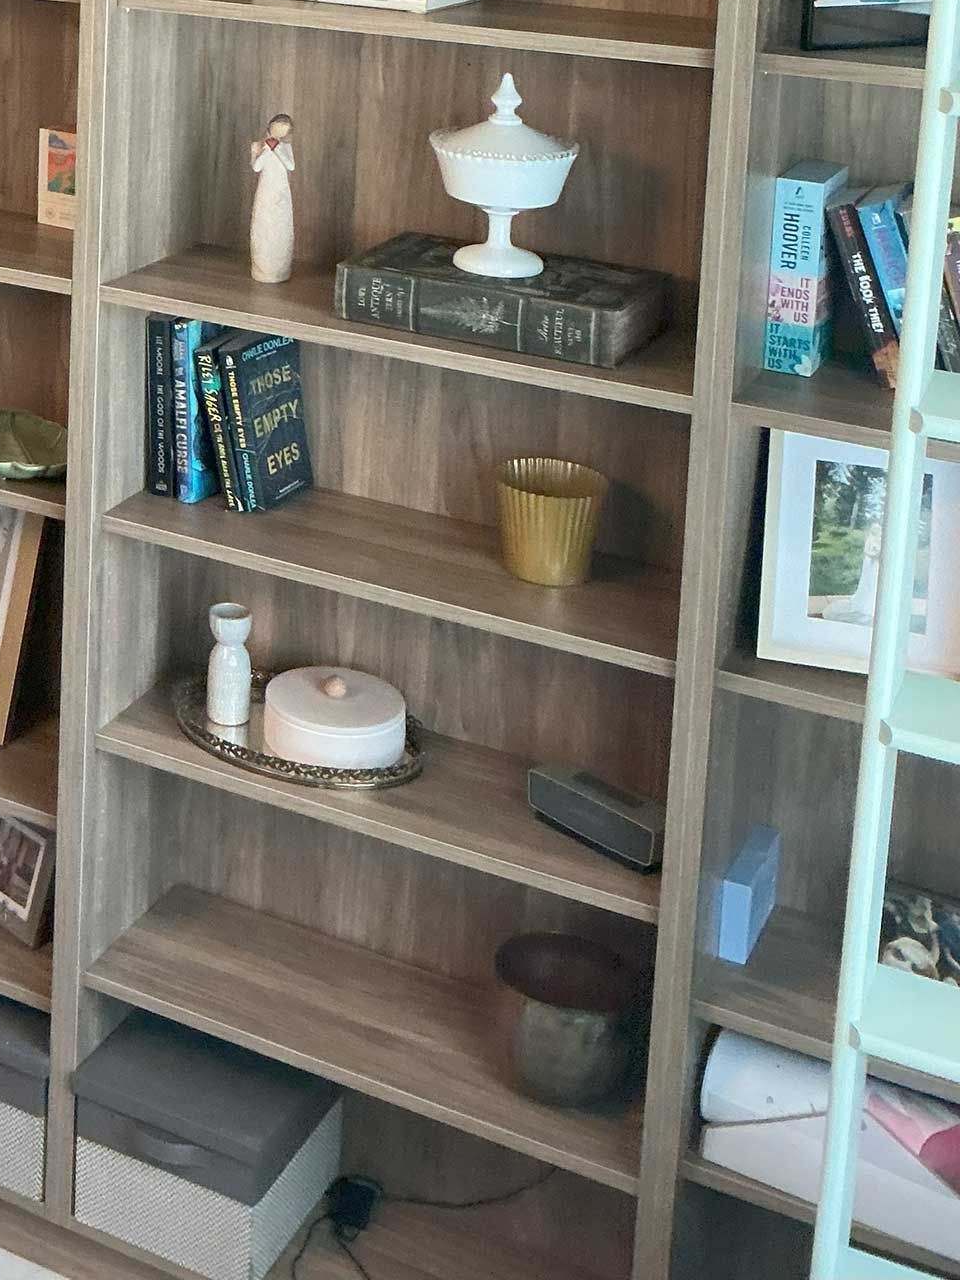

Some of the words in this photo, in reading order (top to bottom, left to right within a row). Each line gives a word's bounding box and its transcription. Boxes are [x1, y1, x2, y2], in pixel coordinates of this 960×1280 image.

[780, 212, 801, 270] HOOVER
[800, 225, 812, 261] COLLEEN
[780, 286, 810, 301] ENDS
[800, 277, 810, 289] IT
[371, 277, 383, 320] ANTIQUE
[780, 299, 809, 312] WITH
[770, 323, 780, 334] IT
[793, 311, 809, 324] US
[769, 334, 811, 351] STARTS
[769, 347, 796, 360] WITH
[198, 354, 215, 385] RILEY
[768, 357, 783, 370] US
[227, 371, 239, 397] THOSE
[249, 365, 292, 395] THOSE
[174, 379, 187, 428] AMALFI
[204, 387, 224, 422] SAGER
[232, 399, 244, 426] EMPTY
[253, 399, 299, 439] EMPTY
[176, 432, 188, 474] CURSE
[236, 428, 247, 449] EYES
[157, 442, 165, 474] WOODS
[266, 442, 300, 476] EYES
[245, 480, 258, 509] DONLEA
